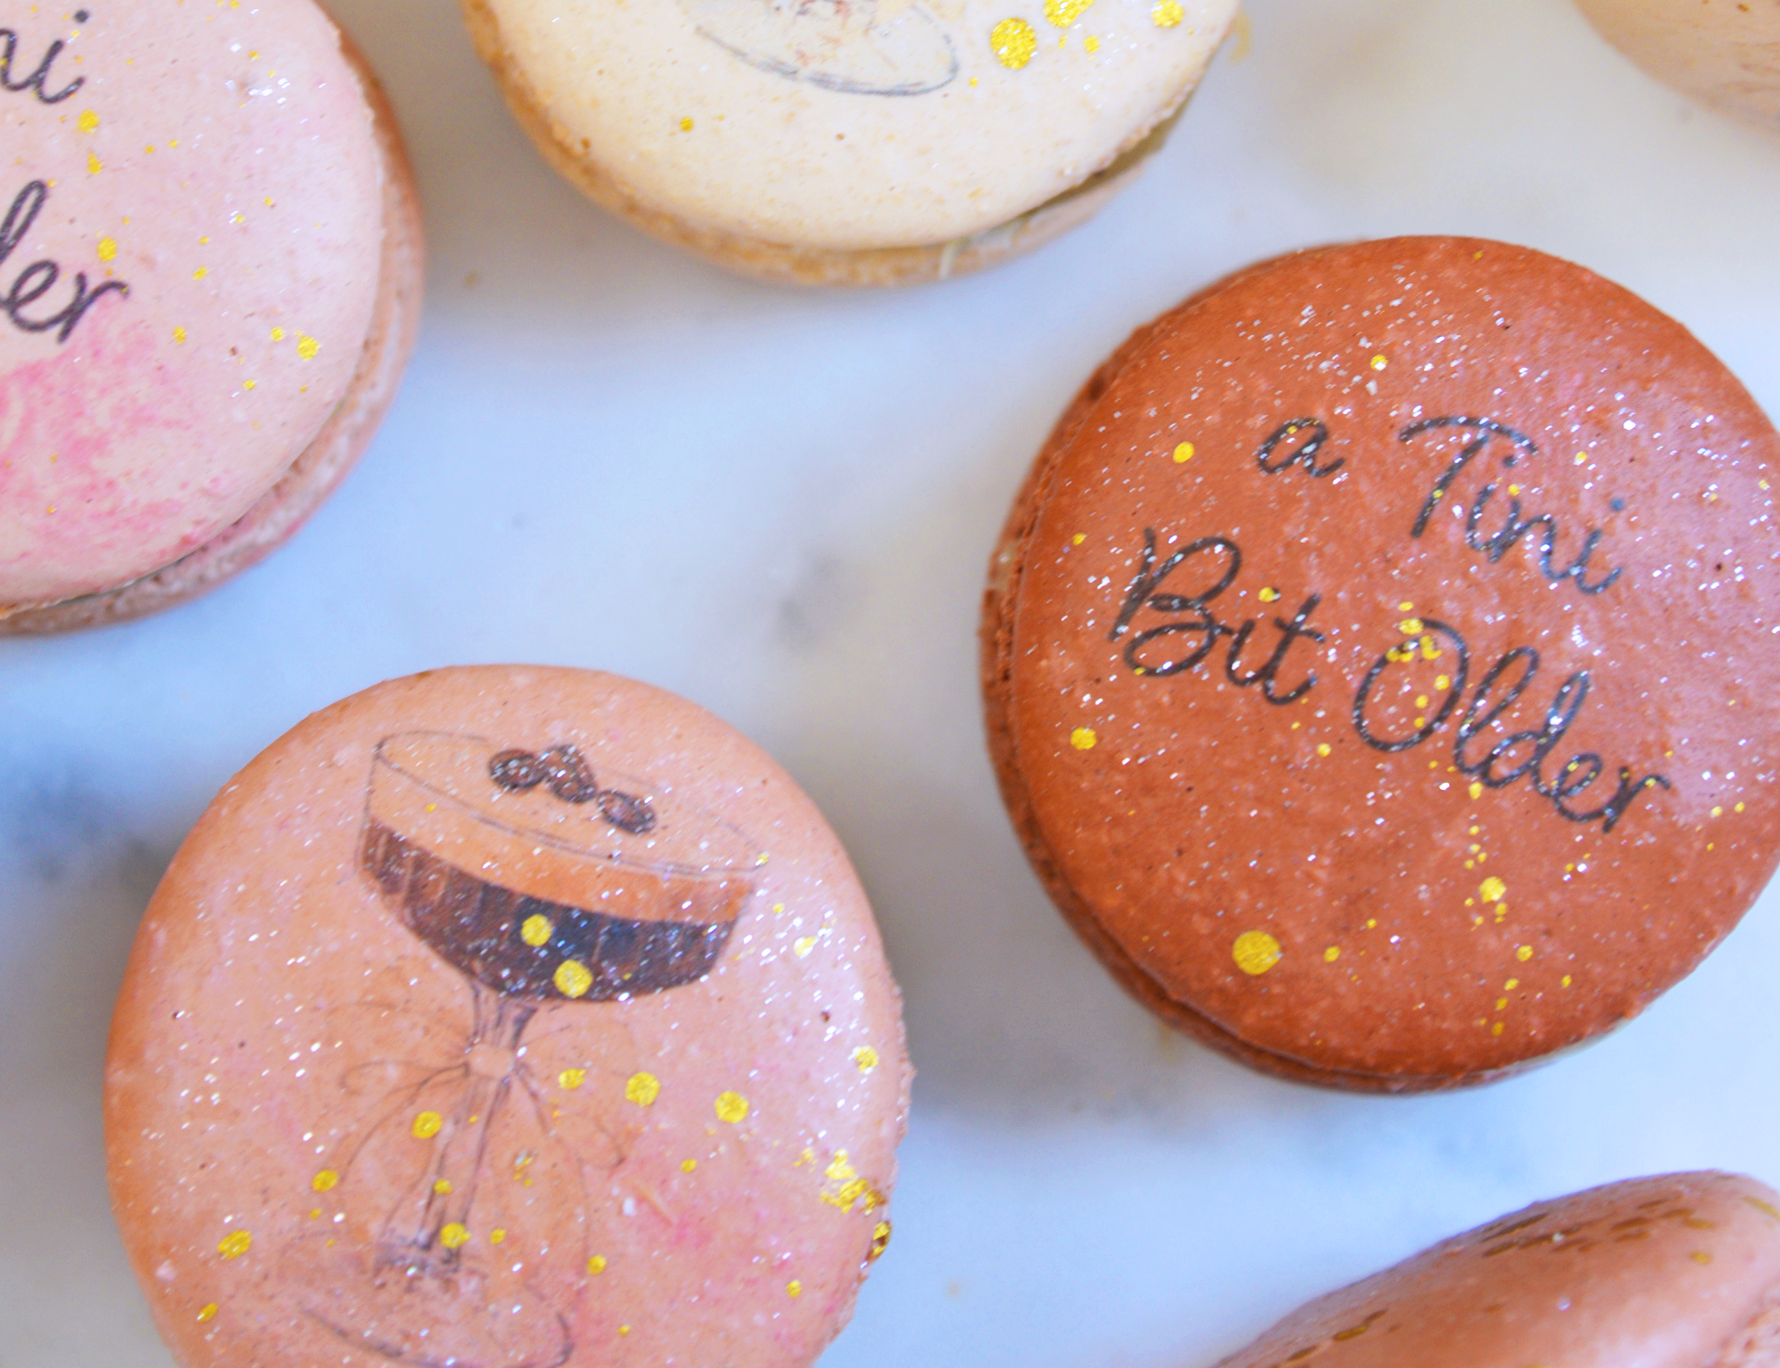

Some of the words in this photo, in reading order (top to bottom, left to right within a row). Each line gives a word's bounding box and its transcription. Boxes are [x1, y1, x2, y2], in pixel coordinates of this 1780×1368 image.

[1256, 418, 1345, 477] a
[1399, 416, 1622, 595] Tini
[1109, 527, 1325, 705] Bit
[1353, 618, 1671, 834] Older
